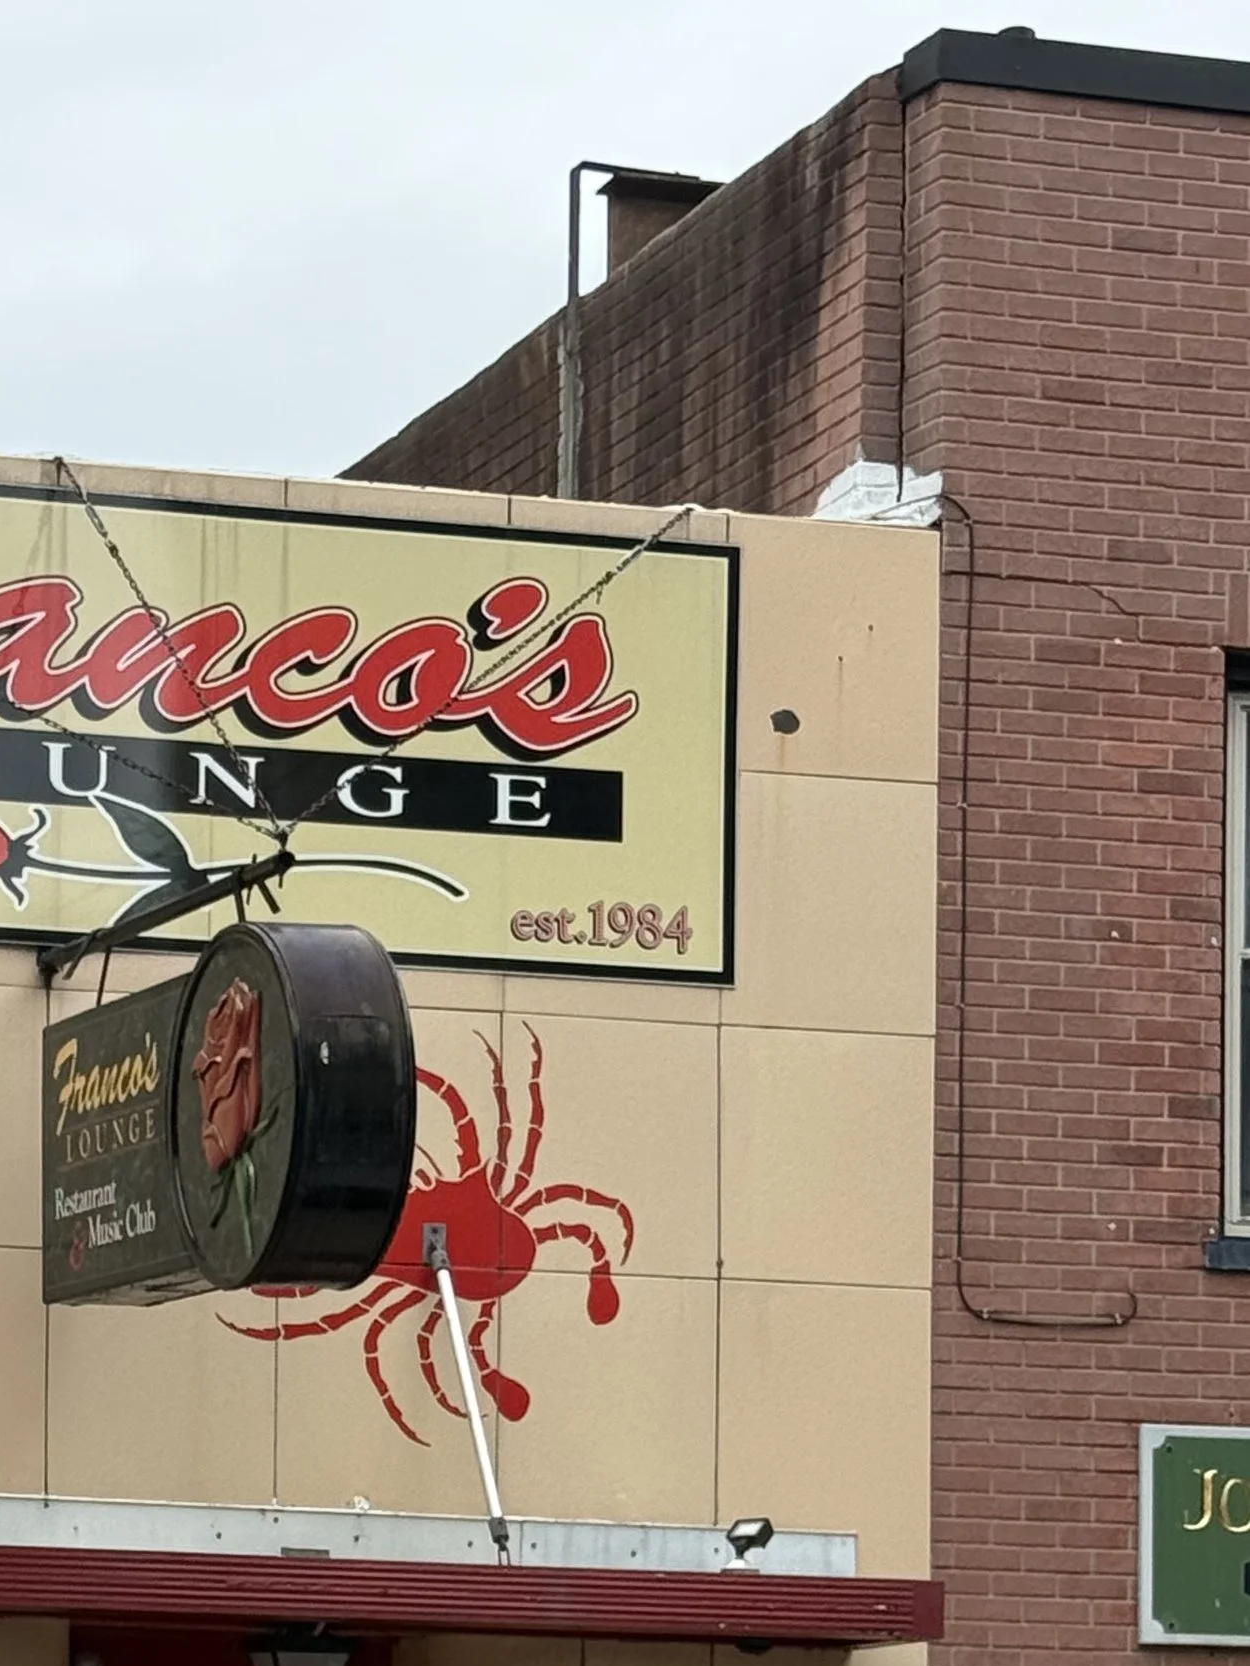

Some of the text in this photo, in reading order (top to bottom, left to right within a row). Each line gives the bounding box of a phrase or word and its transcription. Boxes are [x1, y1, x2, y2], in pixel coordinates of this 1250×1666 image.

[510, 901, 693, 953] est.1984
[53, 1032, 160, 1136] Franco's
[66, 1108, 156, 1163] LOUNGE
[54, 1181, 117, 1221] Restaurant
[87, 1209, 124, 1249] Music
[125, 1198, 156, 1238] Club
